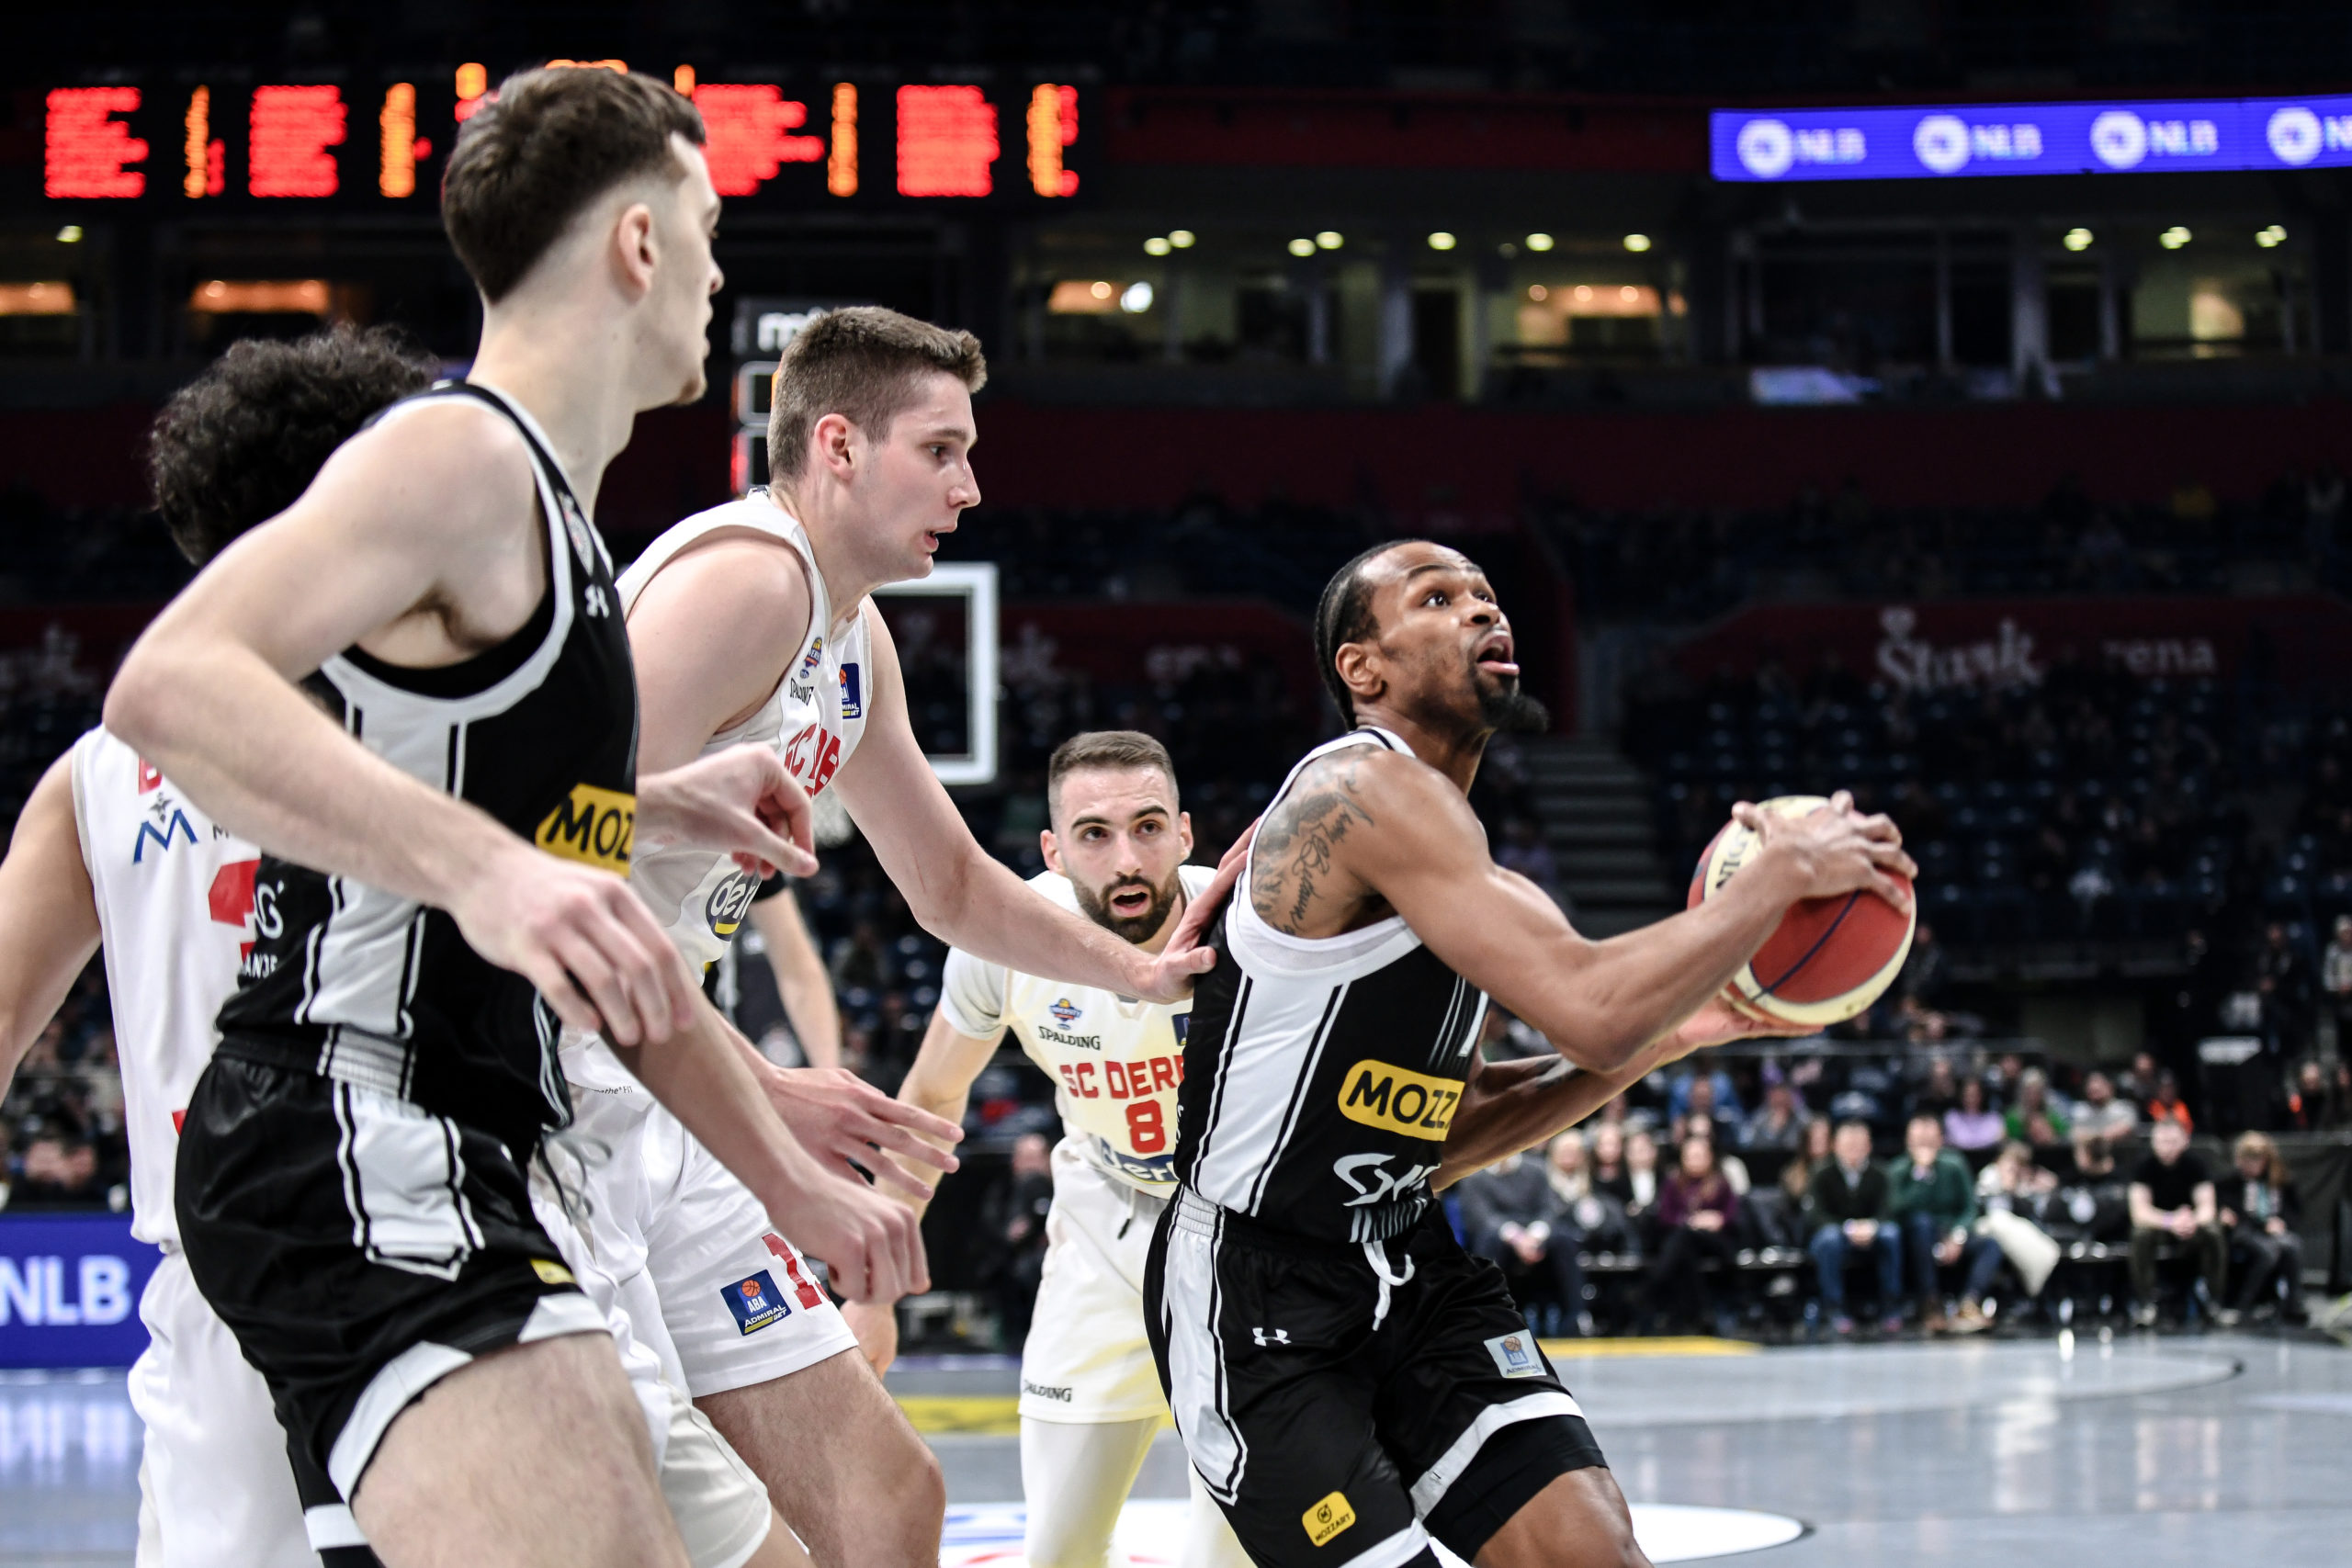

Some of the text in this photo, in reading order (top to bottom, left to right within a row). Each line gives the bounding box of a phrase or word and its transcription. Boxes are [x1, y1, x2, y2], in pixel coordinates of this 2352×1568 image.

[1793, 128, 1867, 164] NLB
[1971, 123, 2044, 161] NLB
[2147, 118, 2220, 157] NLB
[1038, 1026, 1101, 1050] SPALDING
[1060, 1063, 1099, 1098] SC
[1125, 1100, 1166, 1154] 8
[0, 1255, 132, 1325] NLB
[747, 1296, 767, 1314] ABA
[745, 1304, 786, 1327] ADMIRAL
